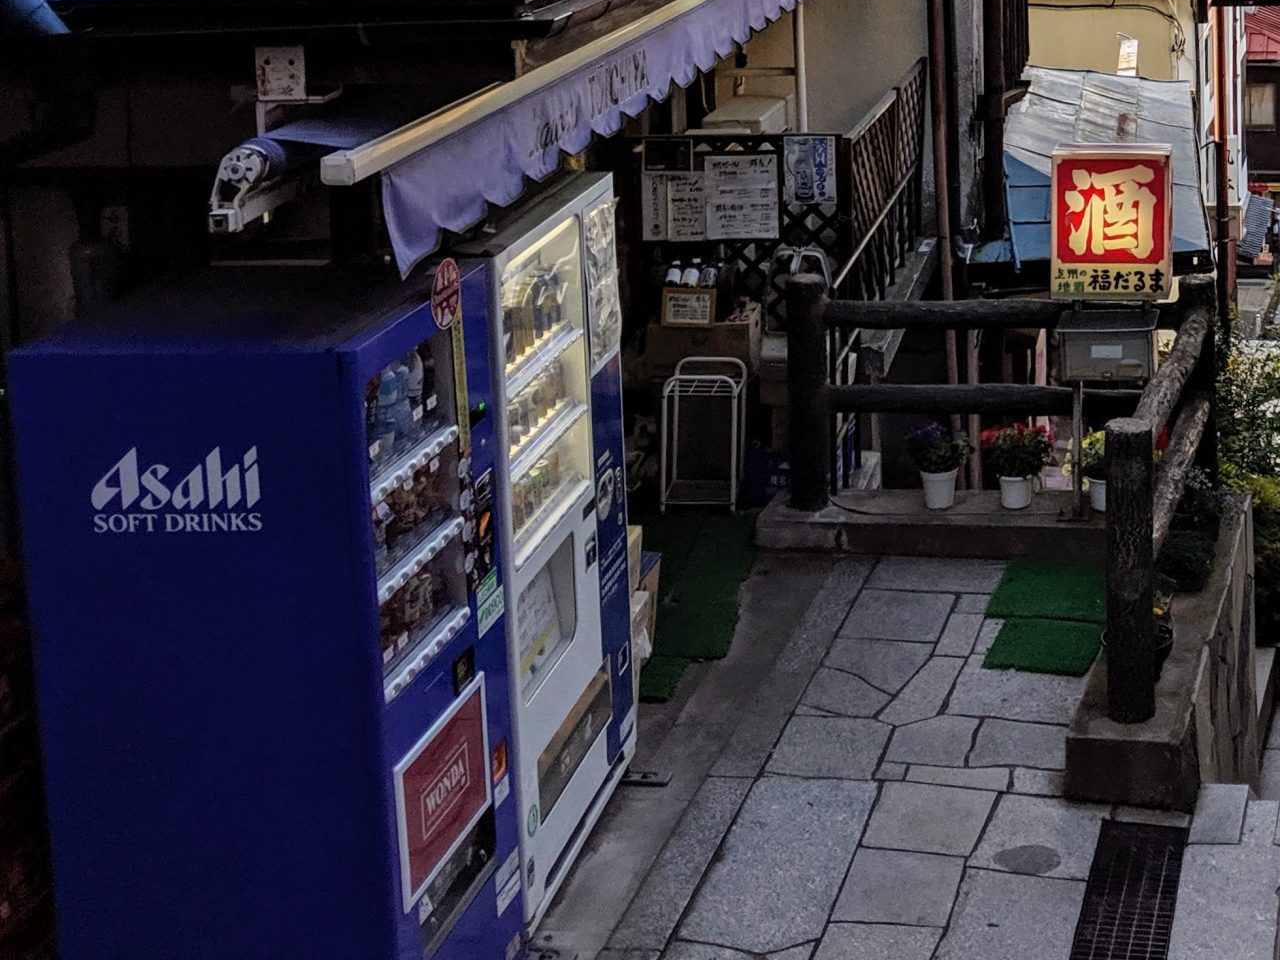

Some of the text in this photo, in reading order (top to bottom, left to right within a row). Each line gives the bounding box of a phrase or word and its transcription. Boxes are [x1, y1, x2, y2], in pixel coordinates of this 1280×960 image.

[1064, 164, 1157, 260] 酒
[1087, 268, 1165, 293] 福だるま
[89, 444, 261, 512] Asahi
[93, 511, 264, 534] SOFT DRINKS
[424, 756, 466, 816] WONDA
